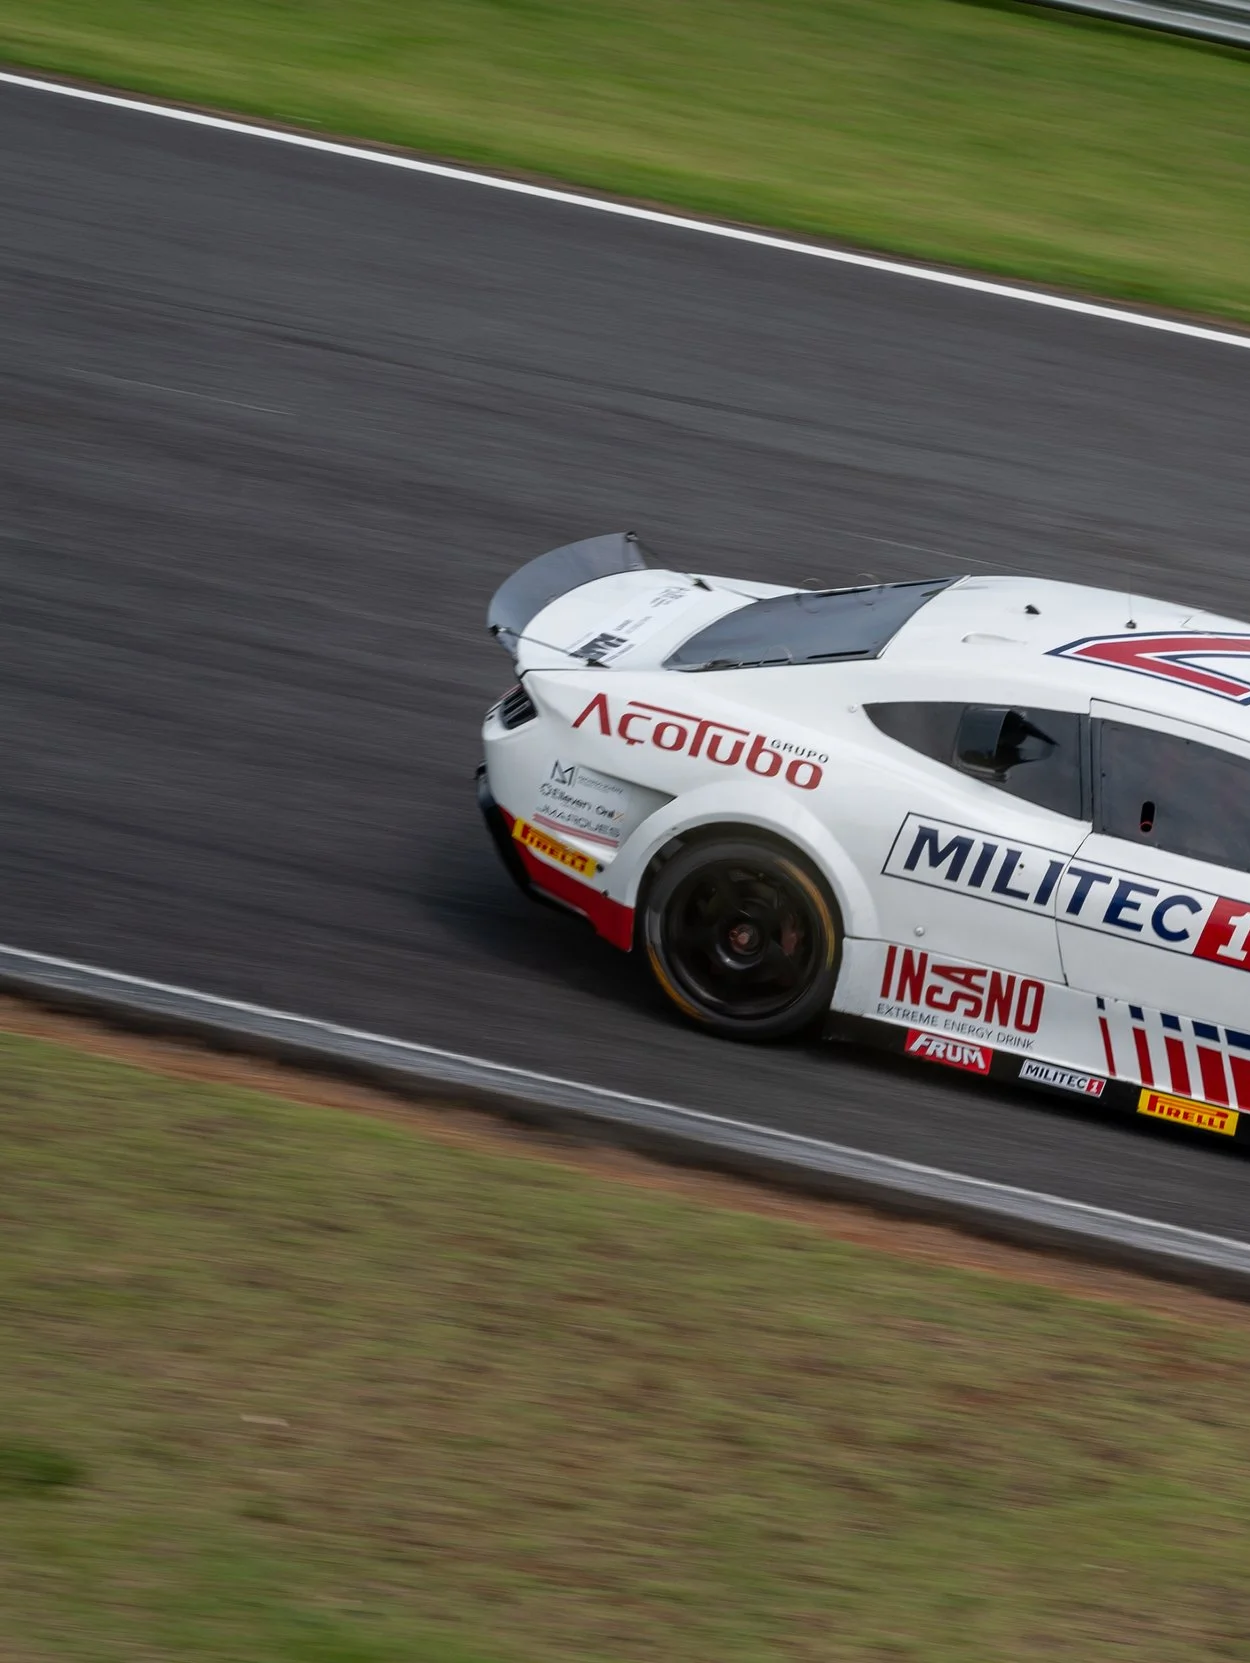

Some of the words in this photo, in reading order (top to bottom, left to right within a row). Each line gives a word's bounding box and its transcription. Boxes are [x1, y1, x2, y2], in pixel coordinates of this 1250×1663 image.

[572, 692, 823, 790] AçoTubo
[770, 738, 829, 764] GRUPO
[520, 822, 589, 873] PIRELLI
[903, 824, 1204, 943] MILITEC
[880, 944, 1045, 1035] INSANO
[876, 1002, 939, 1028] EXTREME
[943, 1014, 993, 1041] ENERGY
[997, 1031, 1036, 1051] DRINK
[909, 1031, 987, 1071] FRUM
[1024, 1063, 1088, 1090] MILITEC
[1147, 1093, 1230, 1131] PIRELLI
